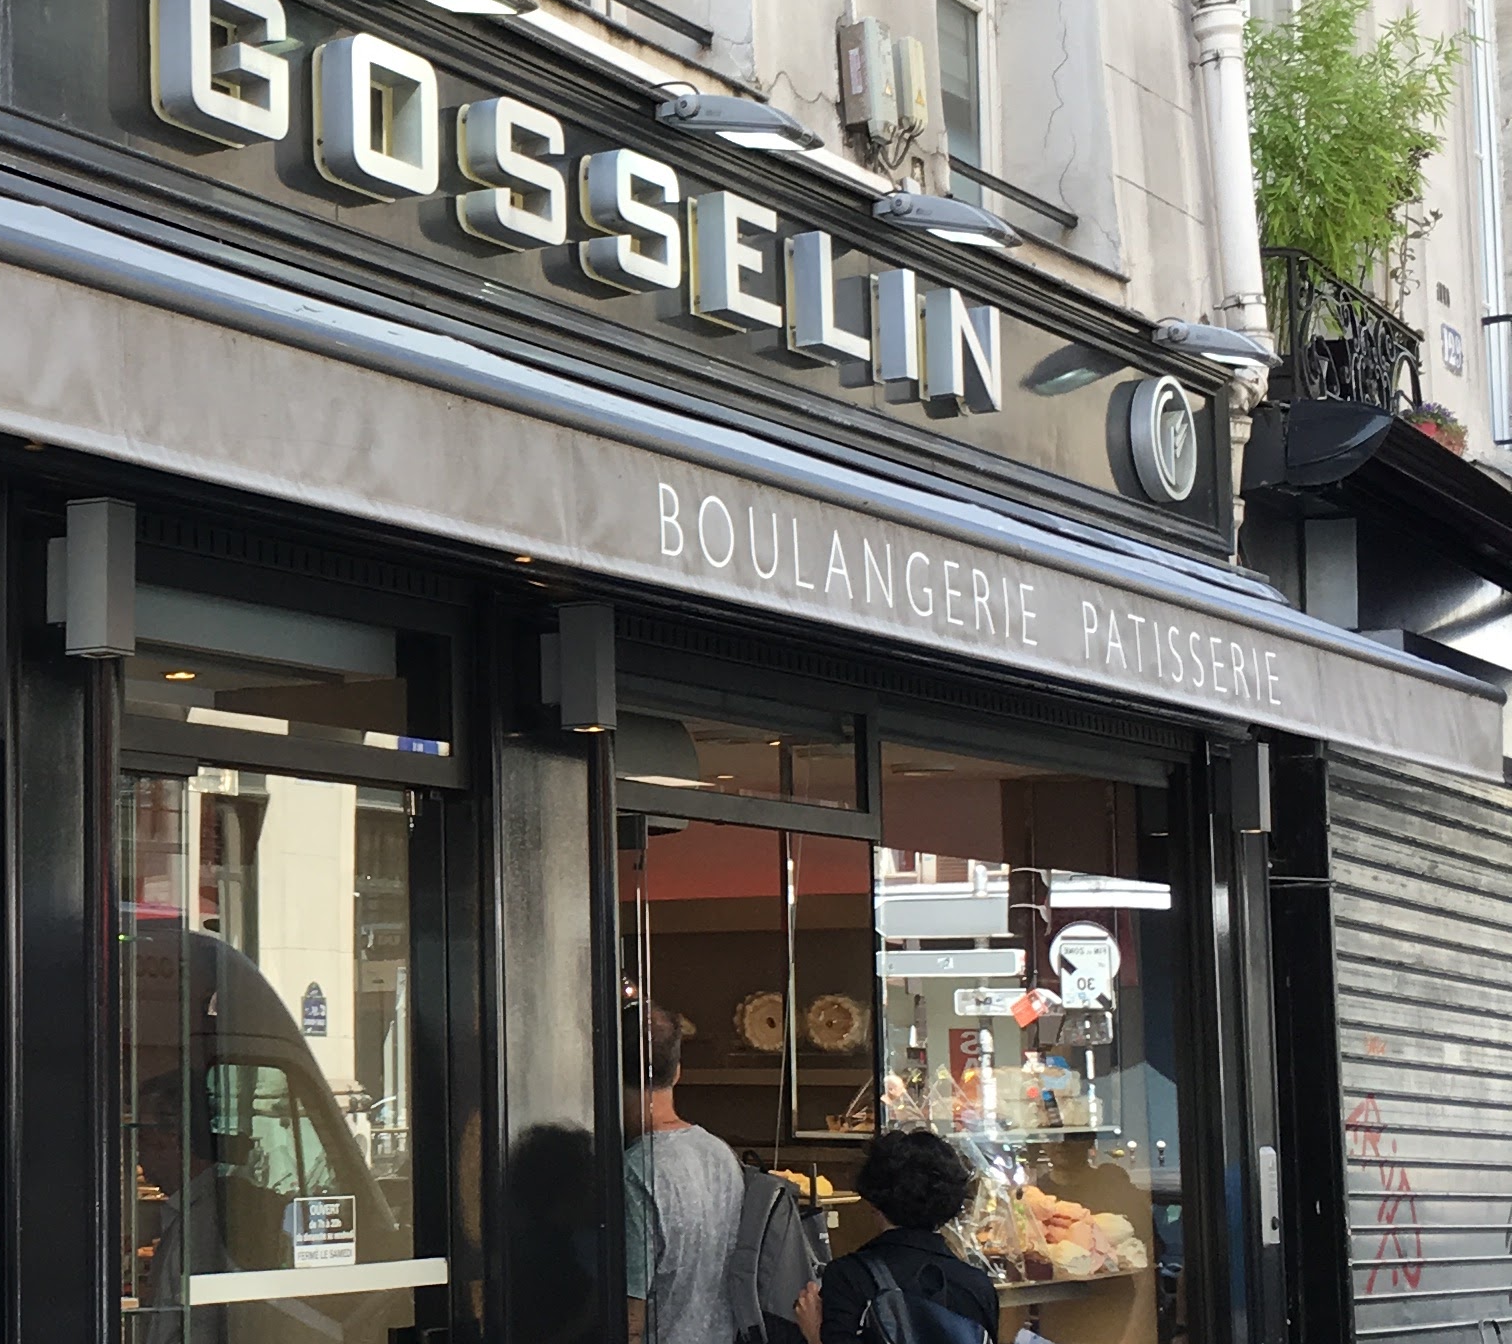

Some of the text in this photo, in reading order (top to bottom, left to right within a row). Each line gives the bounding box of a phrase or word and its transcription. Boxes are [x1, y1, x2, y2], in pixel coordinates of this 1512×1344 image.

[1443, 327, 1462, 368] 129
[658, 482, 1282, 706] BOULANGERIE PATISSERIE
[310, 1203, 340, 1216] OUVERT
[320, 1249, 328, 1259] LE
[330, 1248, 353, 1259] SAMEDI
